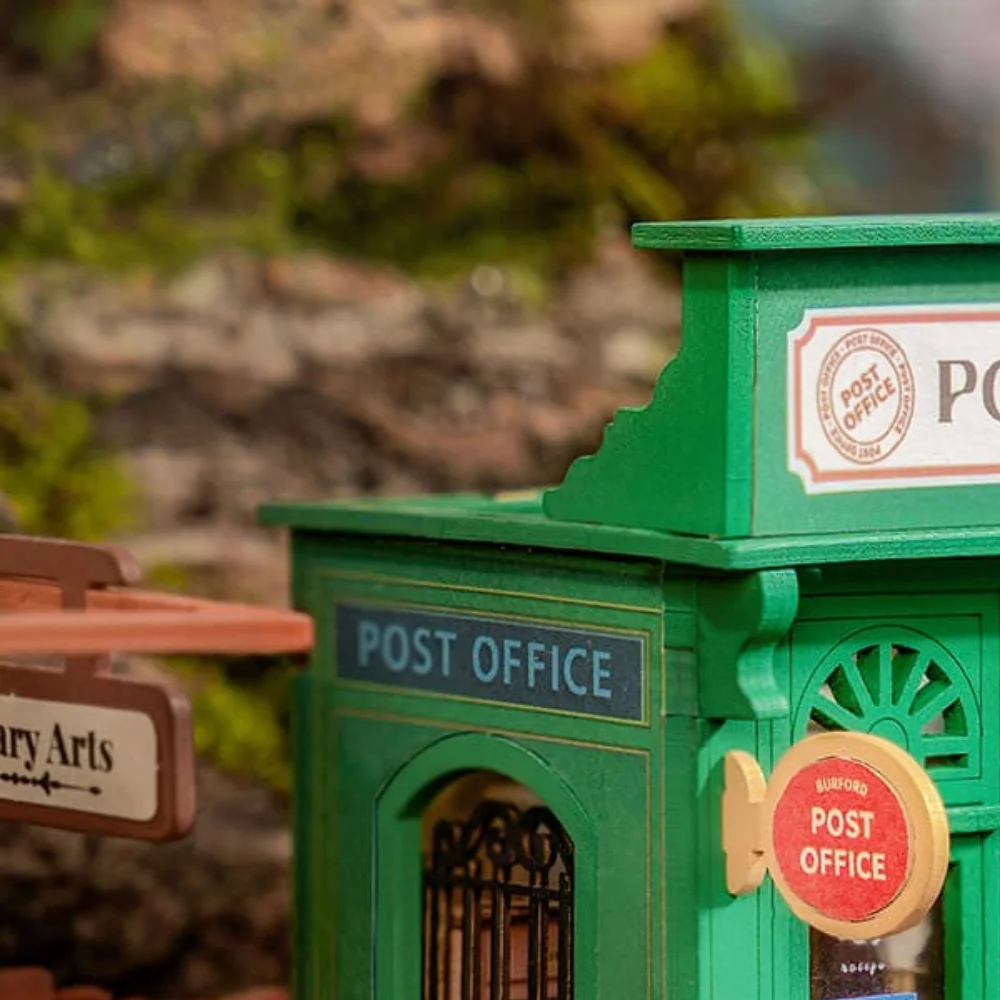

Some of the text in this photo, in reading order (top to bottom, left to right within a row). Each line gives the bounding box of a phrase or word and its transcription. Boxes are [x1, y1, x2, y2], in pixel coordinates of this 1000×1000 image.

[841, 363, 881, 409] POST
[843, 376, 896, 431] OFFICE
[357, 620, 612, 698] POST OFFICE
[46, 721, 114, 773] Arts
[816, 777, 868, 796] BURFORD
[811, 806, 875, 839] POST
[800, 847, 887, 880] OFFICE
